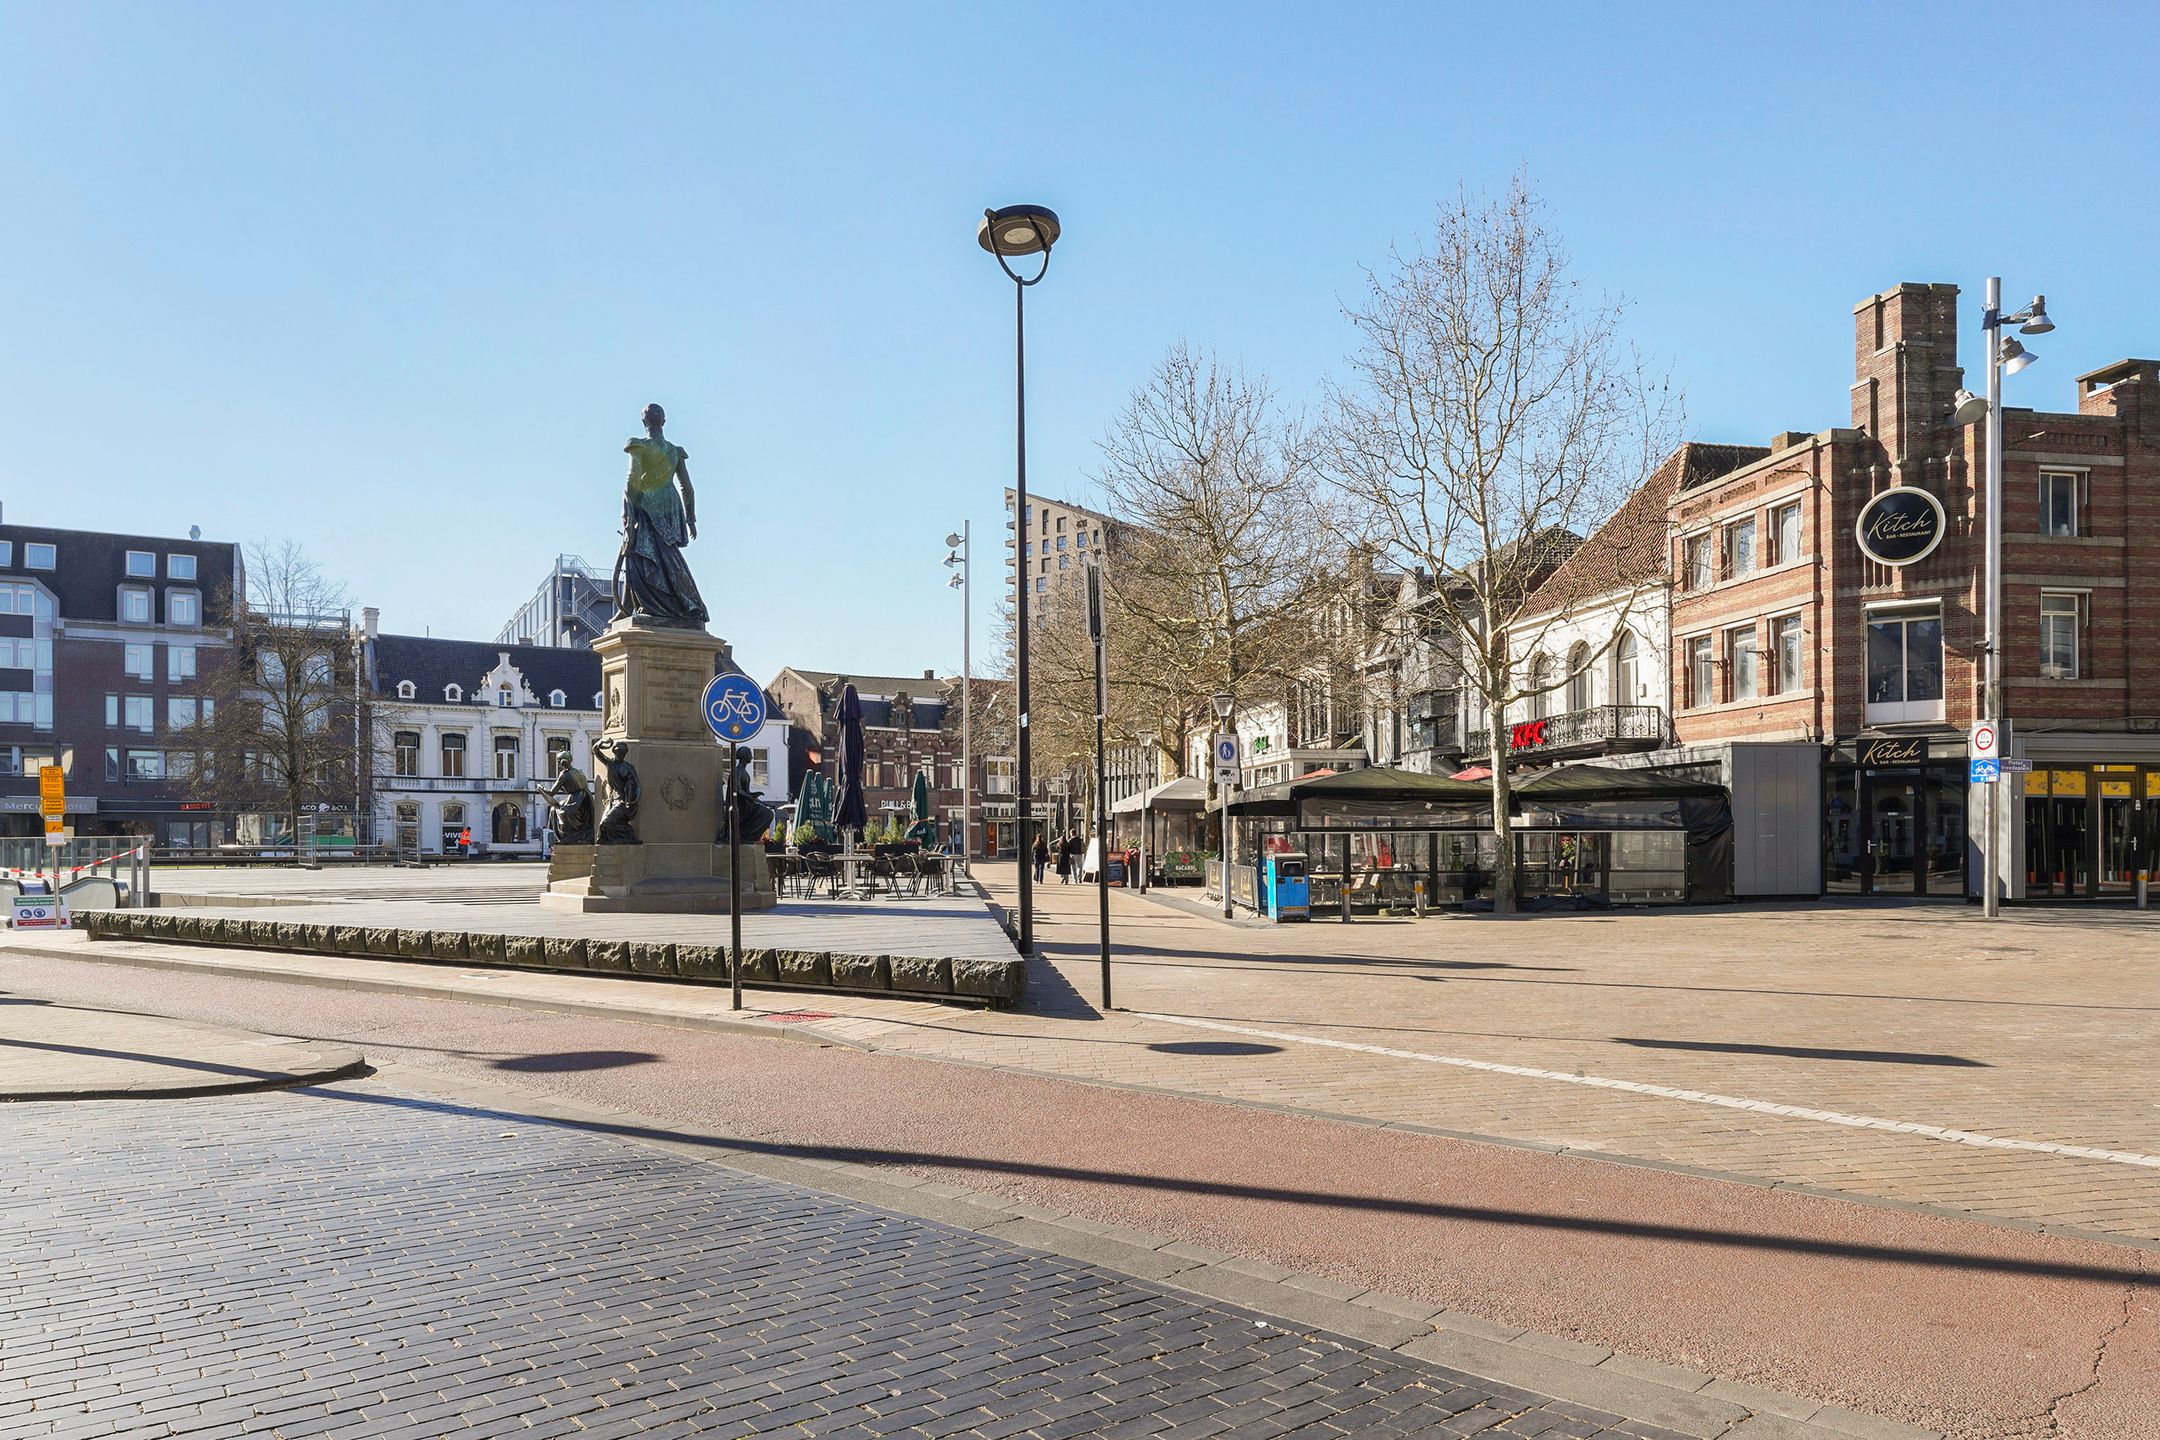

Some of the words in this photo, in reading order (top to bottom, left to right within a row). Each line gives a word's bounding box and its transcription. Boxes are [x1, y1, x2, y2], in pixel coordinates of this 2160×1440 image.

[1866, 508, 1932, 540] Kitch
[1899, 530, 1932, 538] RESTAURANT
[1511, 720, 1545, 749] KFC
[1862, 739, 1921, 765] Kitch
